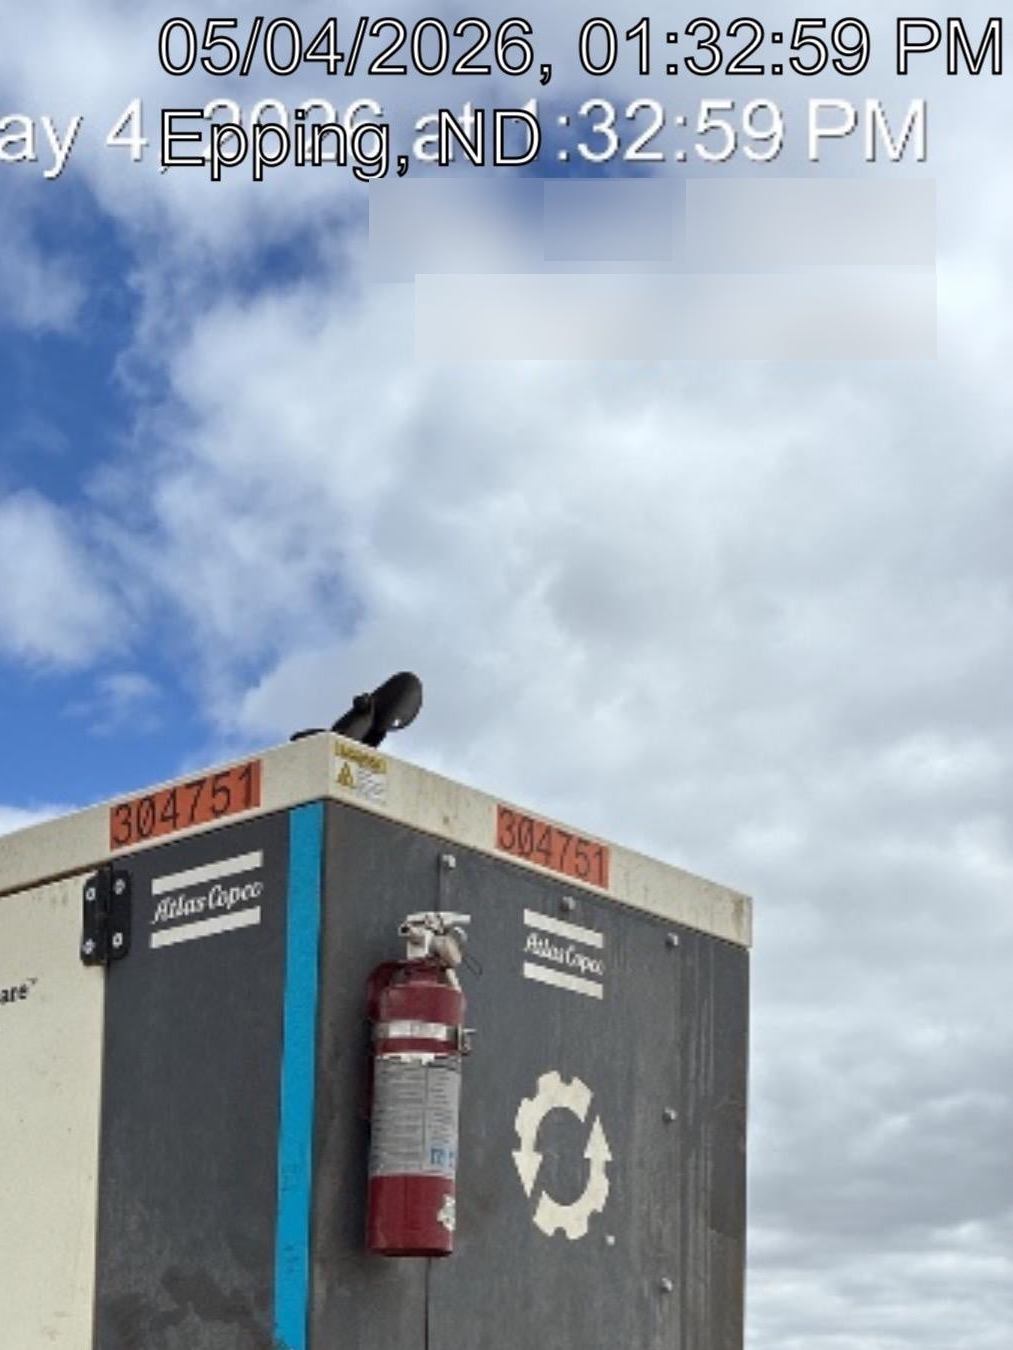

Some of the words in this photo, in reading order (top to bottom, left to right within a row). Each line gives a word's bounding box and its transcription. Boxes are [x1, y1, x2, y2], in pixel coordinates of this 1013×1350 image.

[114, 763, 253, 845] 304751
[499, 808, 604, 887] 304751
[150, 893, 207, 925] Atlas
[208, 881, 263, 910] Copco
